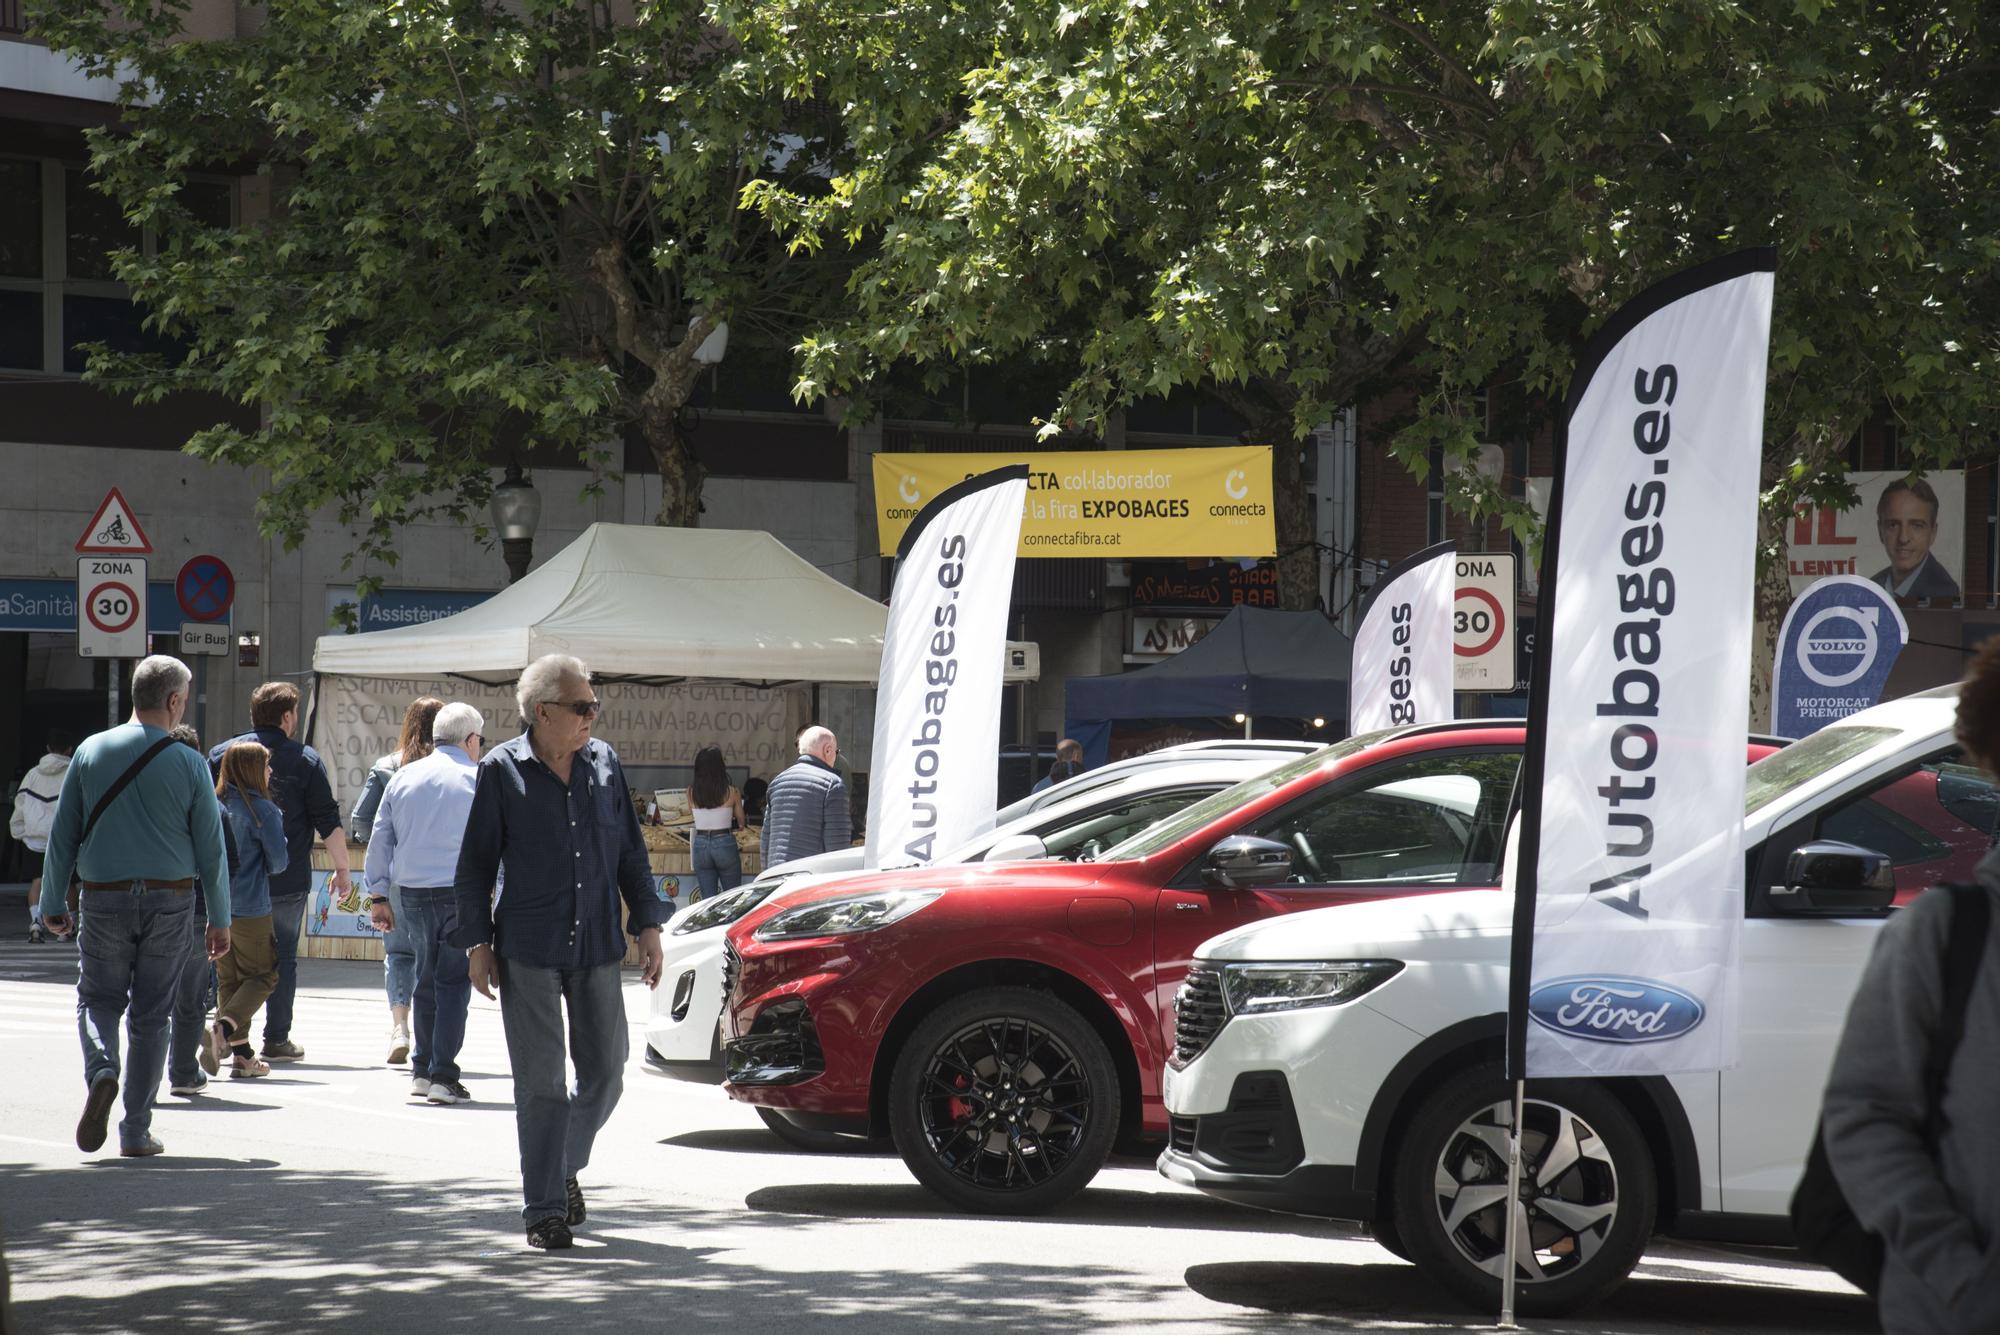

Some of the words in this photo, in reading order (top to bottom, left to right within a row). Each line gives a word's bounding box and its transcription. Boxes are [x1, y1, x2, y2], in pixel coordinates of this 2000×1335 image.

[1031, 499, 1046, 519] la
[1050, 499, 1077, 519] fira
[1082, 500, 1189, 518] EXPOBAGES
[1209, 502, 1266, 517] connecta
[1024, 531, 1121, 546] connectafibra.cat
[92, 563, 133, 575] ZONA
[1232, 589, 1275, 605] BAR
[98, 599, 128, 616] 30
[1454, 611, 1490, 634] 30
[184, 632, 201, 644] Gir
[204, 633, 227, 646] Bus
[1590, 363, 1678, 920] Autobages.es
[1808, 641, 1866, 651] VOLVO
[904, 534, 967, 864] Autobages.es
[1796, 697, 1870, 708] MOTORCAT
[1556, 973, 1671, 1037] Ford
